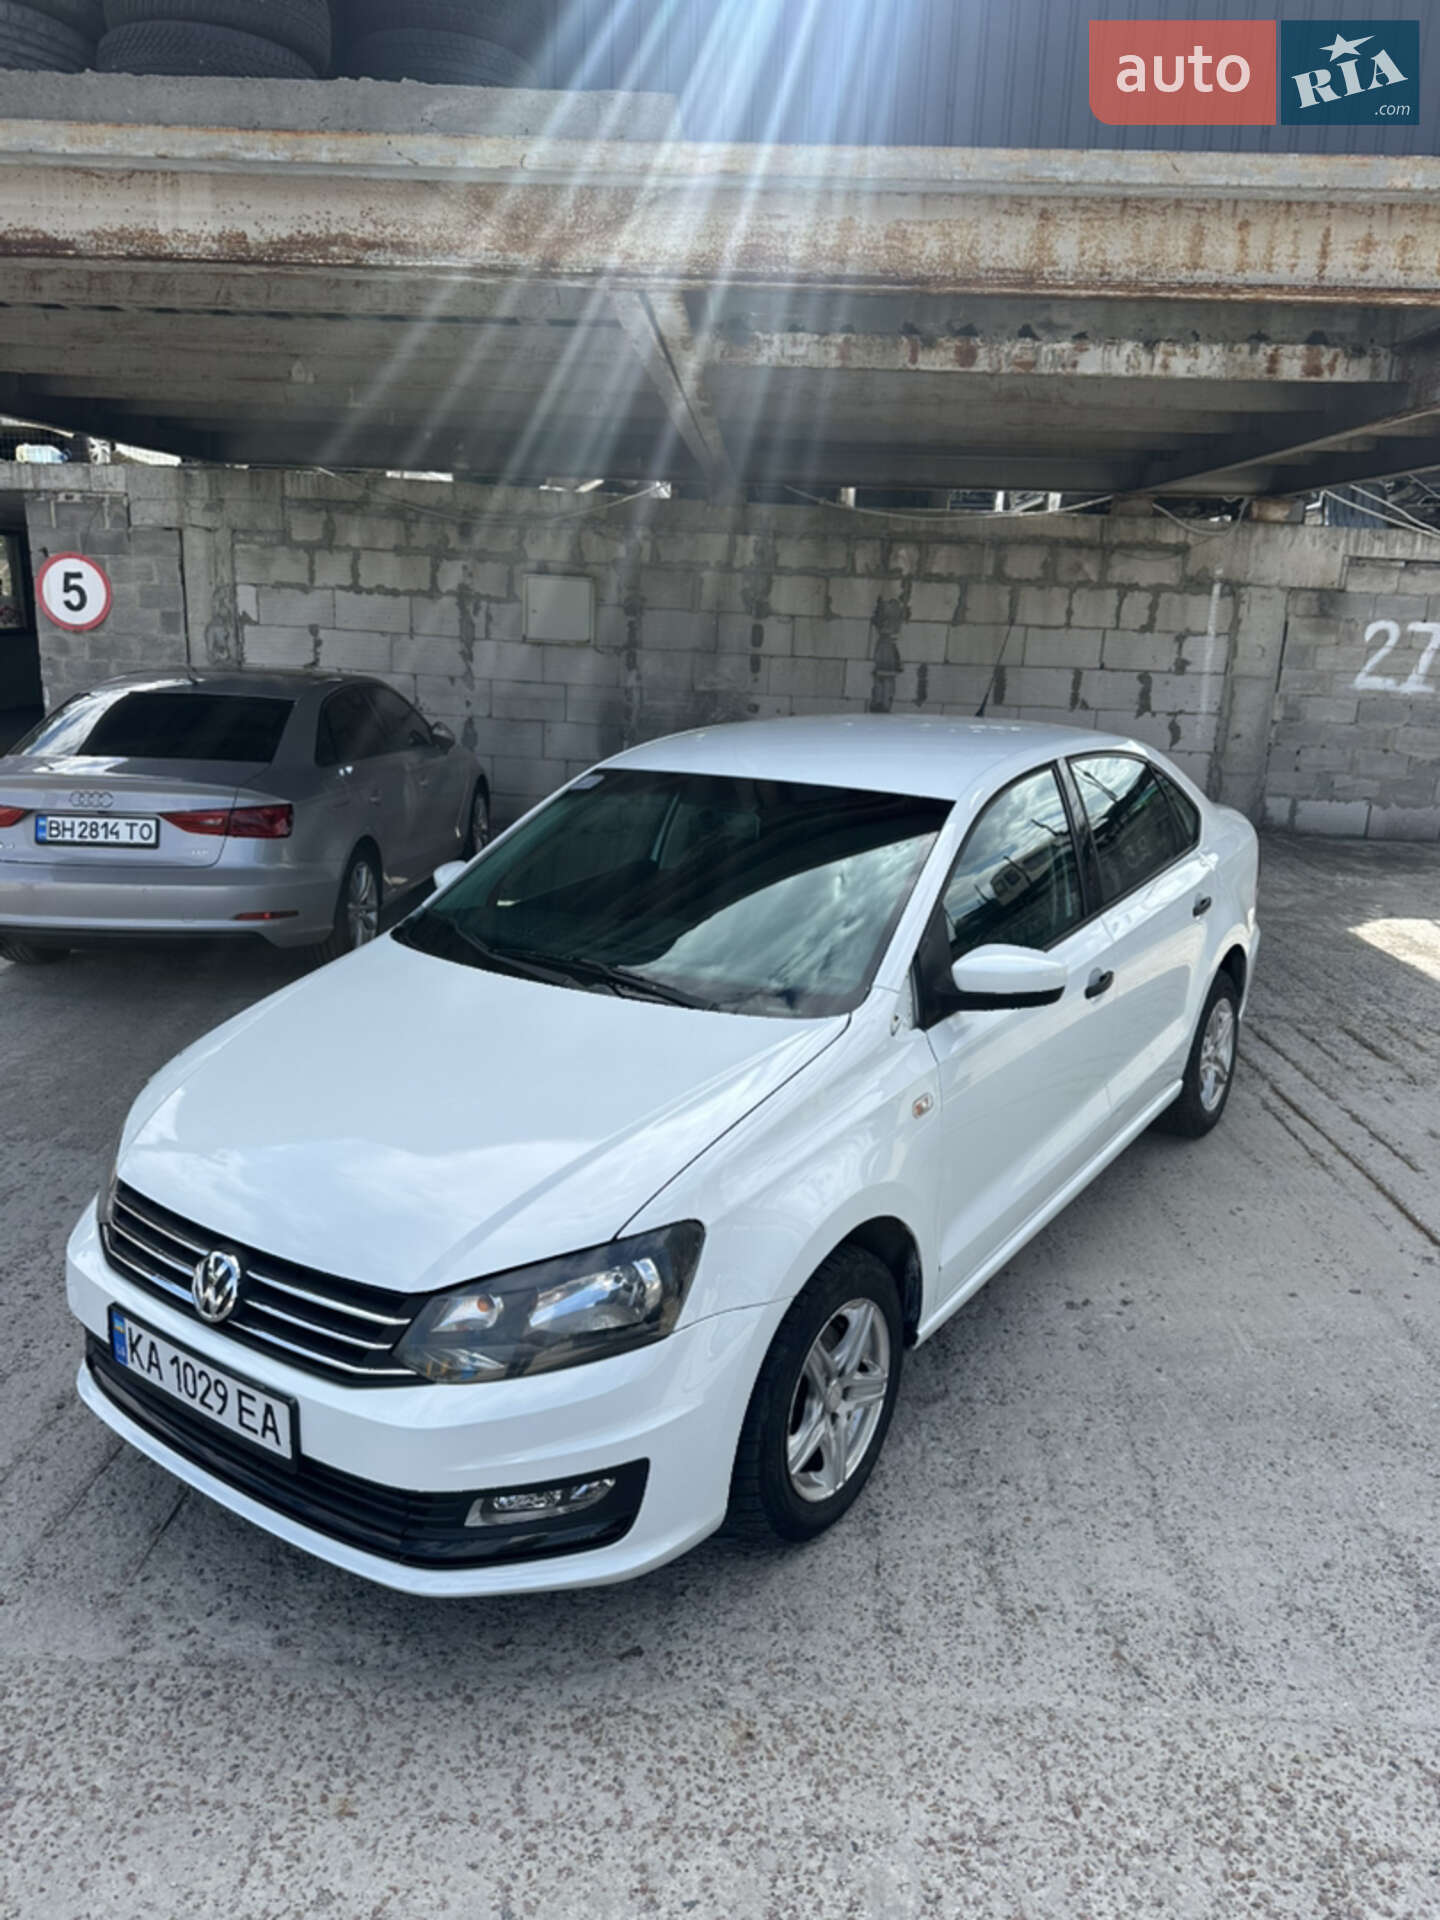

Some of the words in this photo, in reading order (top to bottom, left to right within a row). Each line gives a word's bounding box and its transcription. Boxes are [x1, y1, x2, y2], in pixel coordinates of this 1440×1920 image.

[63, 571, 88, 612] 5
[1354, 620, 1440, 694] 27
[49, 820, 76, 839] BH
[78, 821, 120, 841] 2814
[126, 822, 154, 841] TO
[128, 1327, 164, 1381] KA
[170, 1355, 229, 1416] 1029
[236, 1388, 281, 1446] EA
